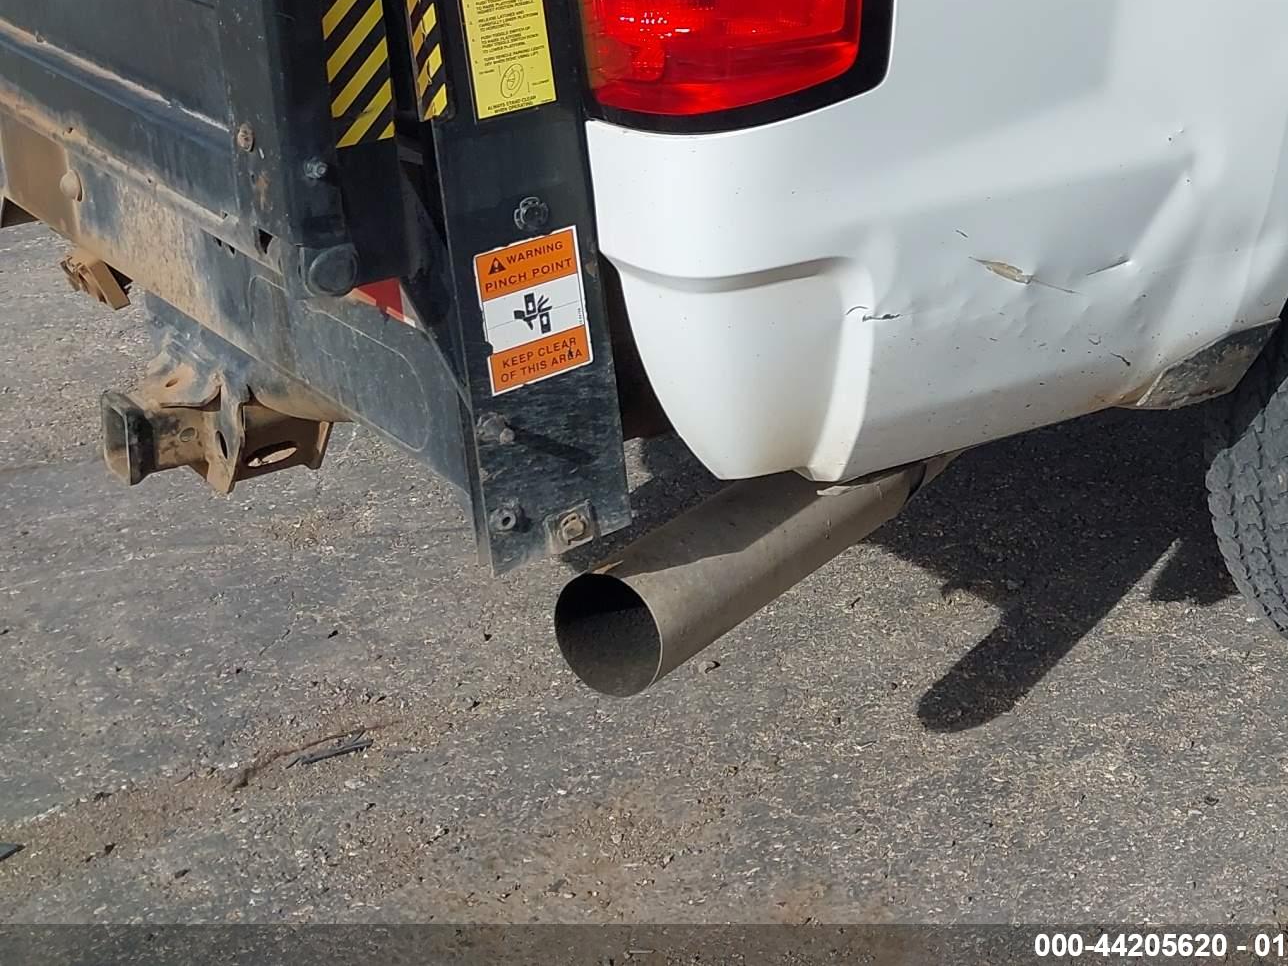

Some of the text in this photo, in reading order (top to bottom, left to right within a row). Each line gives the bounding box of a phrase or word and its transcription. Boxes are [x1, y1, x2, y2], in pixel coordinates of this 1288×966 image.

[506, 240, 563, 265] WARNING
[485, 257, 572, 293] PINCH POINT
[502, 336, 576, 369] KEEP CLEAR
[500, 369, 518, 384] OF
[520, 359, 547, 377] THIS
